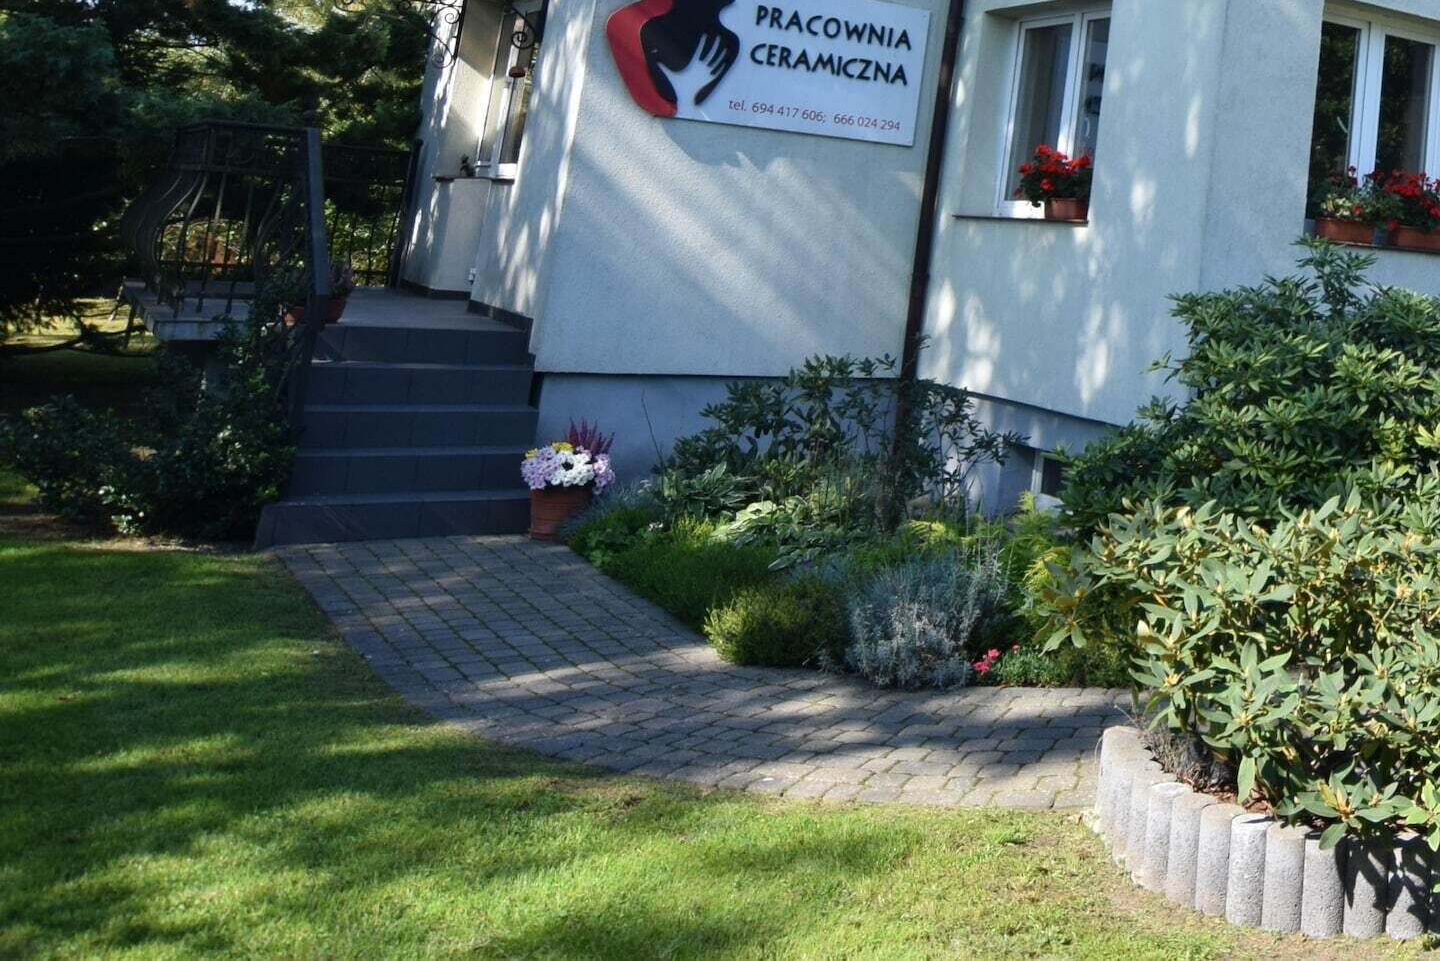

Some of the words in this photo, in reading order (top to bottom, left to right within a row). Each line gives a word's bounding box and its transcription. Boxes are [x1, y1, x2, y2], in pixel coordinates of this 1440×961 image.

[756, 5, 912, 51] PRACOWNIA
[750, 43, 908, 86] CERAMICZNA
[728, 100, 747, 112] tel.
[752, 102, 774, 115] 694
[777, 105, 800, 119] 417
[833, 113, 855, 126] 666
[857, 116, 878, 128] 024
[880, 119, 901, 131] 294
